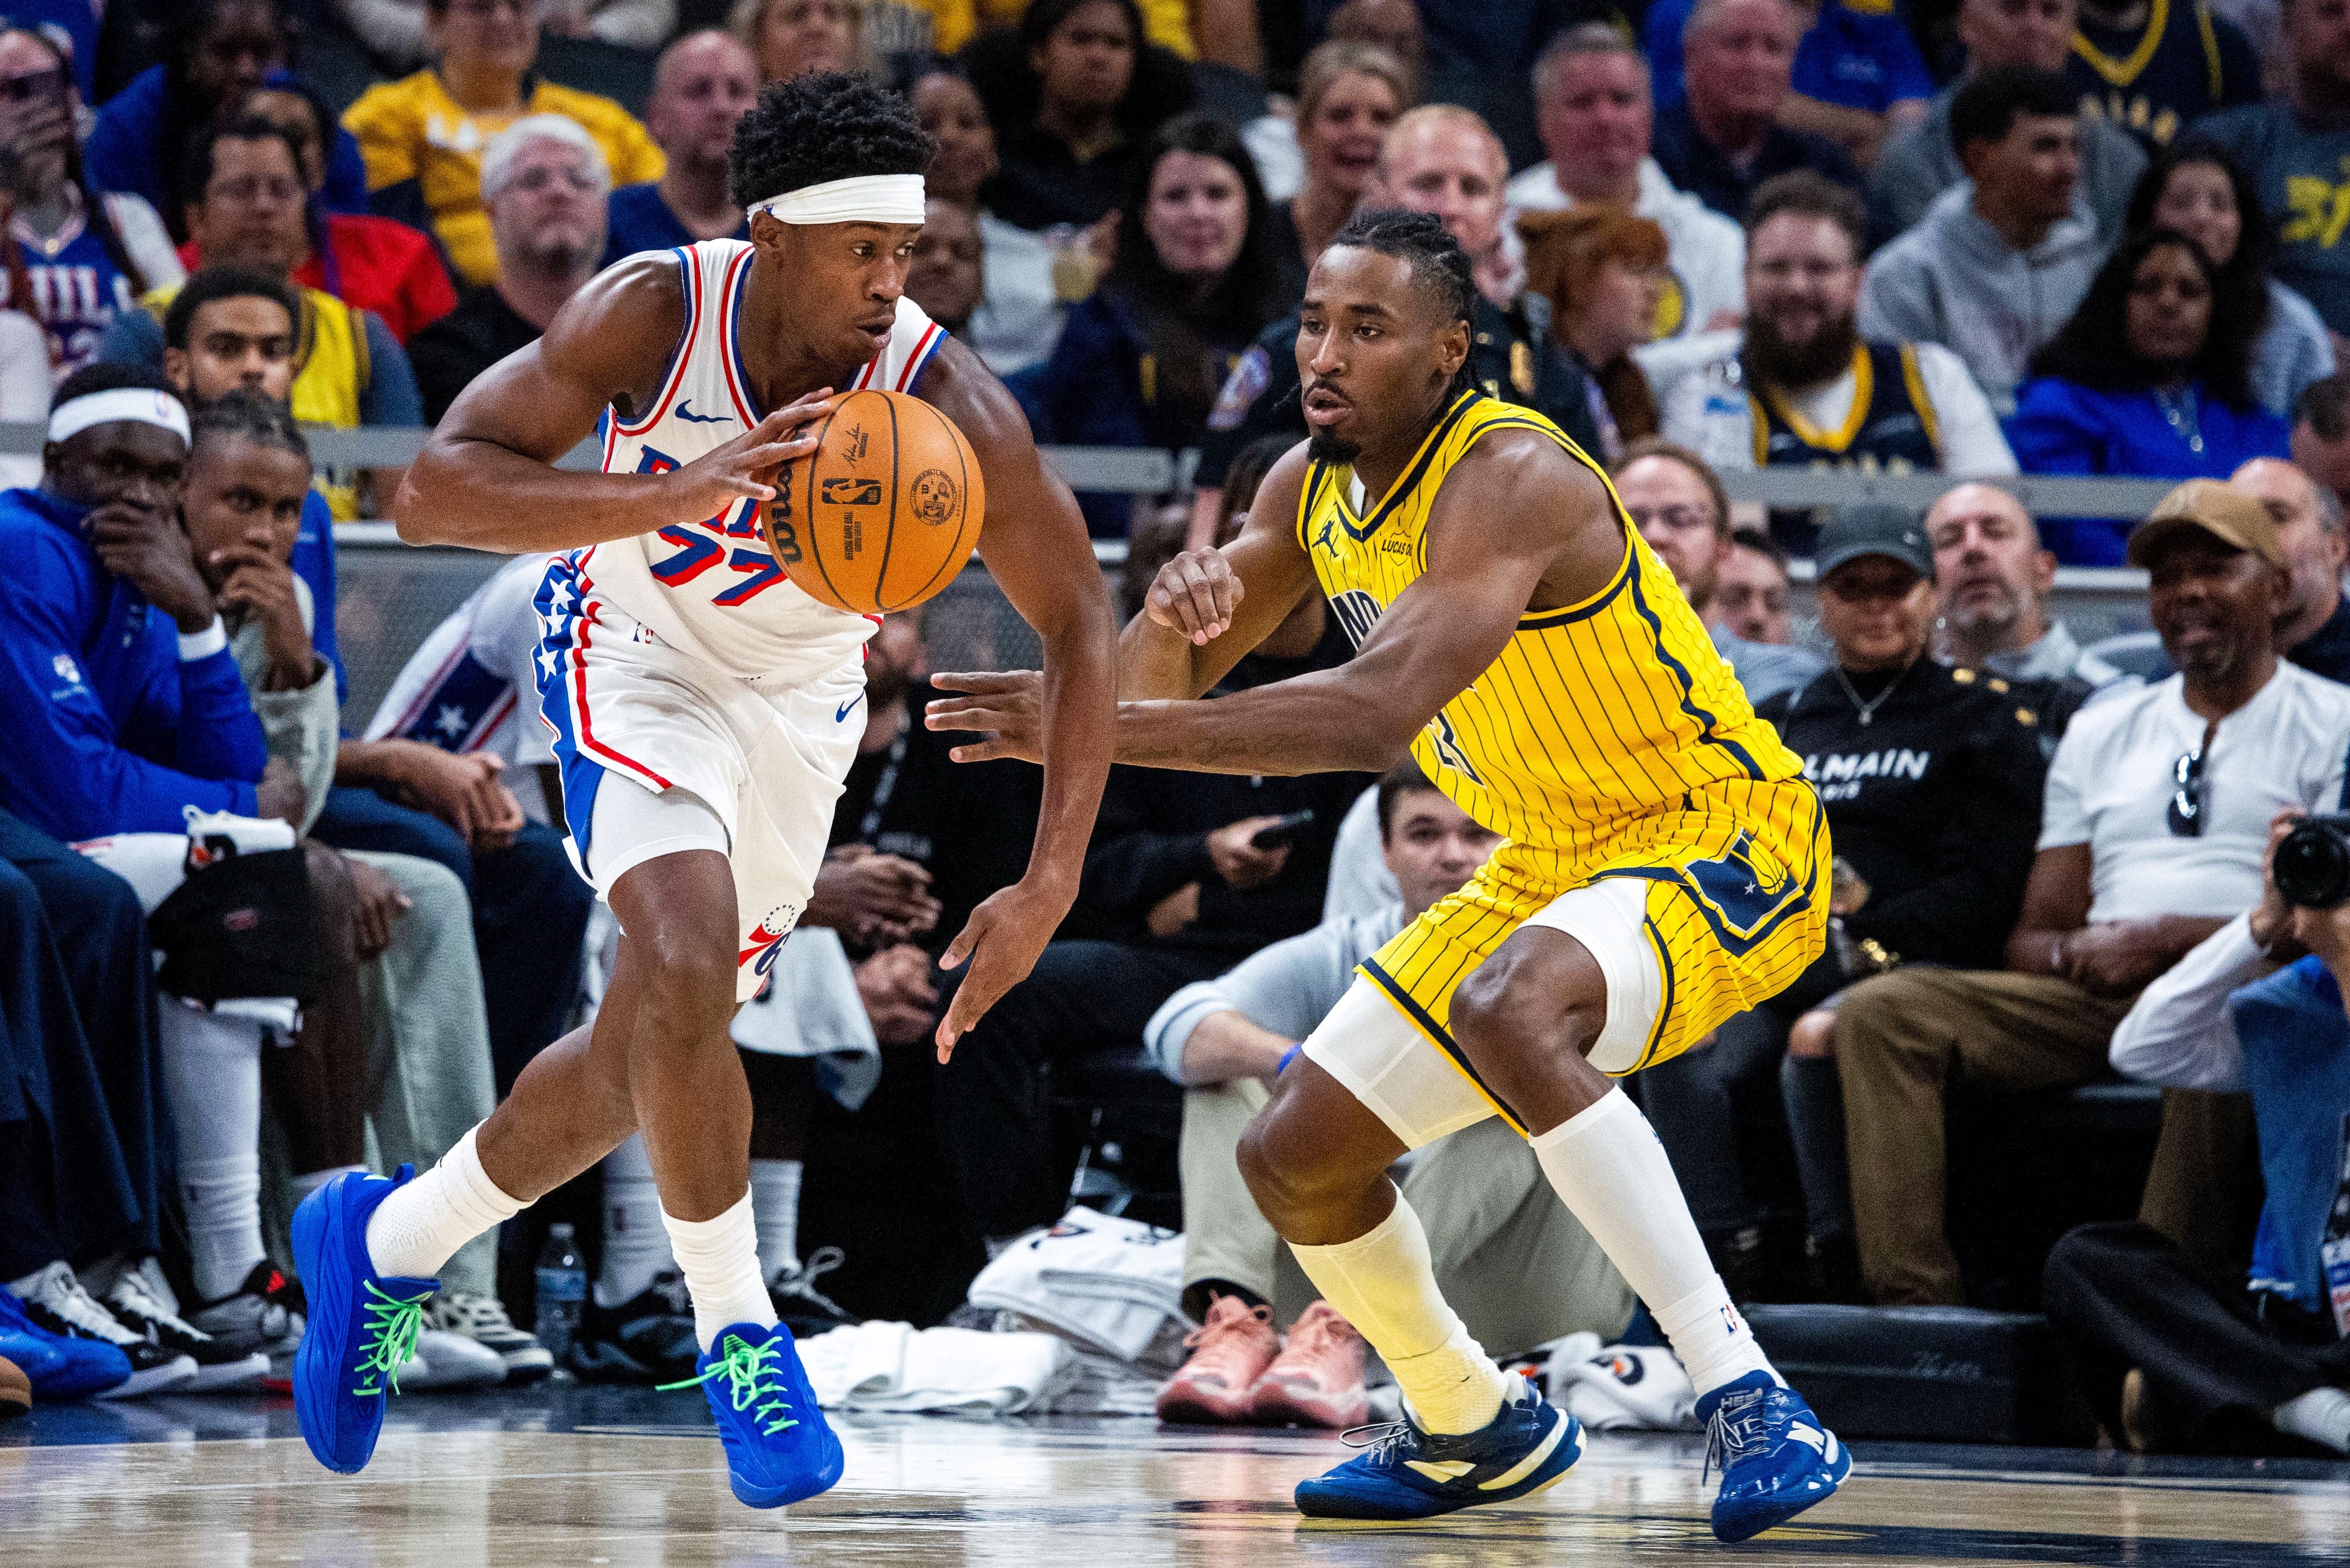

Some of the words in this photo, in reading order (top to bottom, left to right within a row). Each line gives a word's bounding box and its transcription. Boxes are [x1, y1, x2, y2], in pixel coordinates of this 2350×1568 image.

[1381, 539, 1406, 555] LUCAS
[649, 524, 789, 607] 77
[1802, 748, 1931, 783] LMAIN
